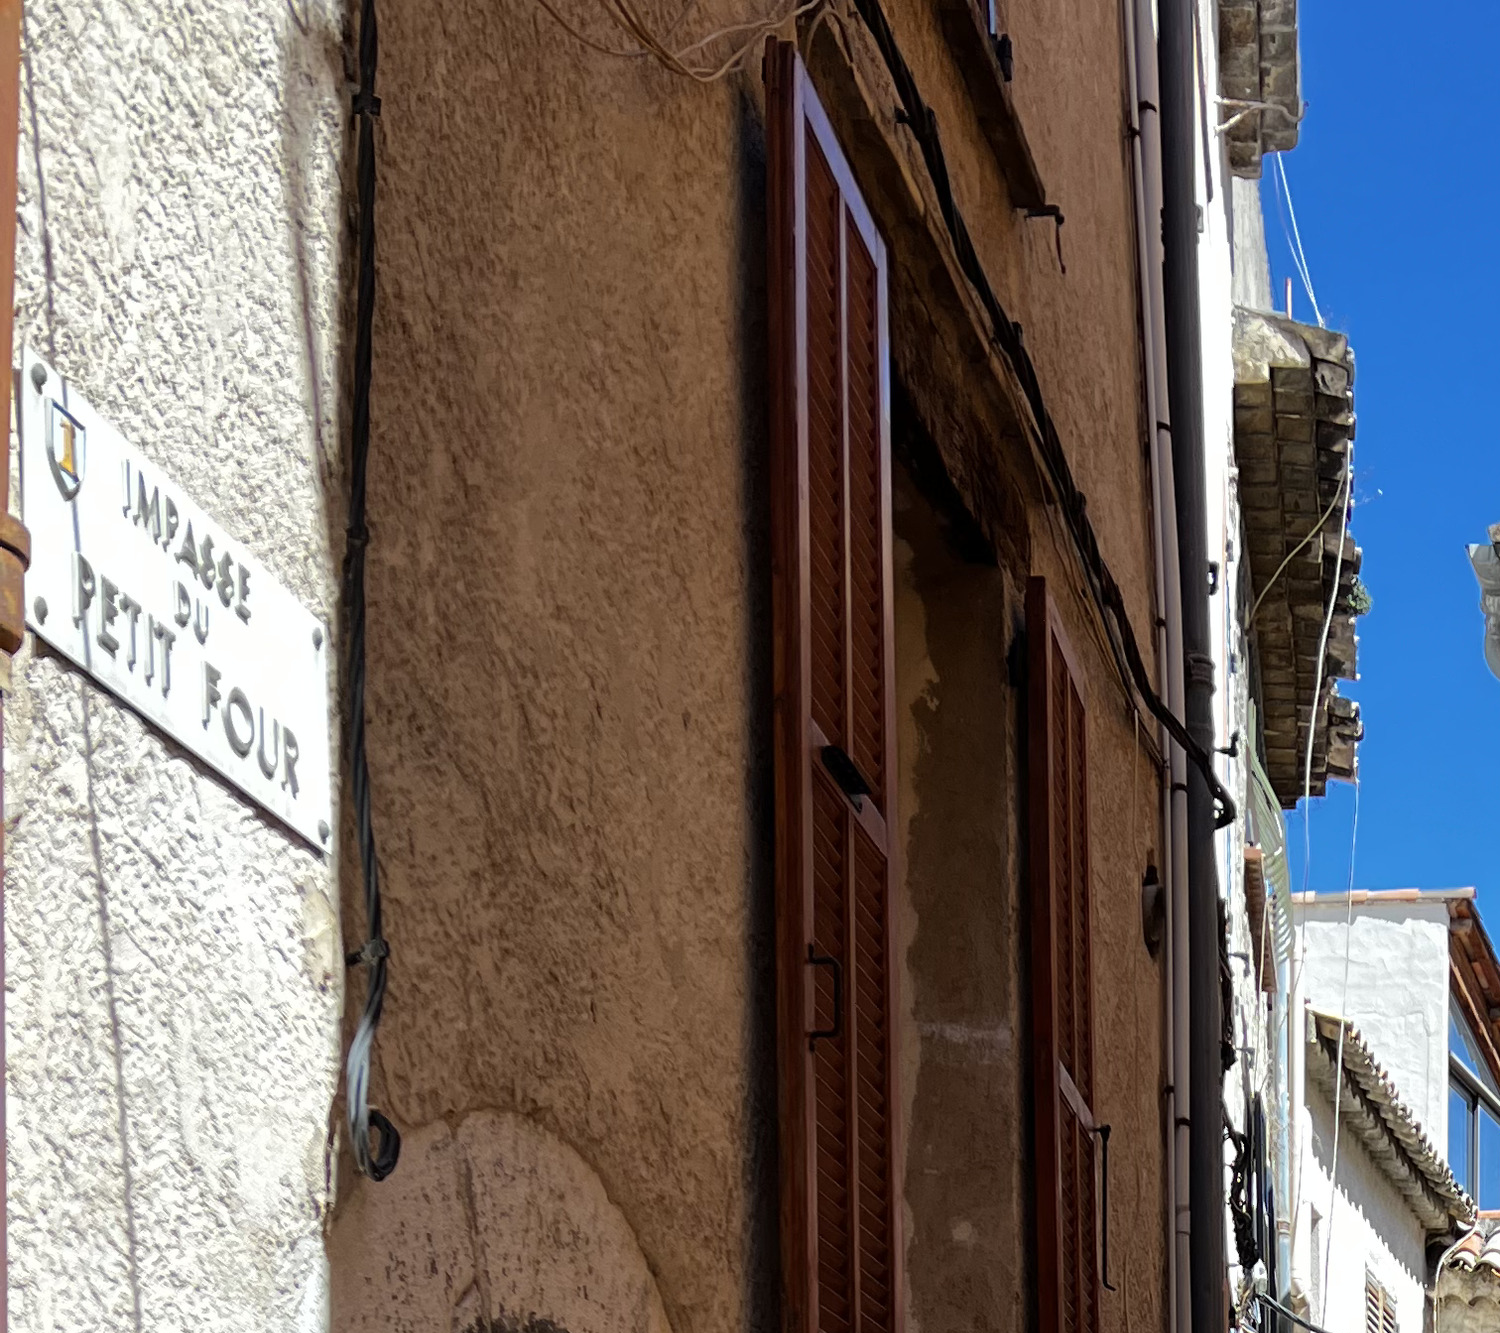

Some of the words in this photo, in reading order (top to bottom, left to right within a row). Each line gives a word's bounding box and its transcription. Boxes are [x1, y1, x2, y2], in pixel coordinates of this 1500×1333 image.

[121, 458, 252, 625] IMPASSE
[173, 579, 210, 646] DU
[71, 550, 177, 699] PETIT
[201, 659, 301, 801] FOUR
